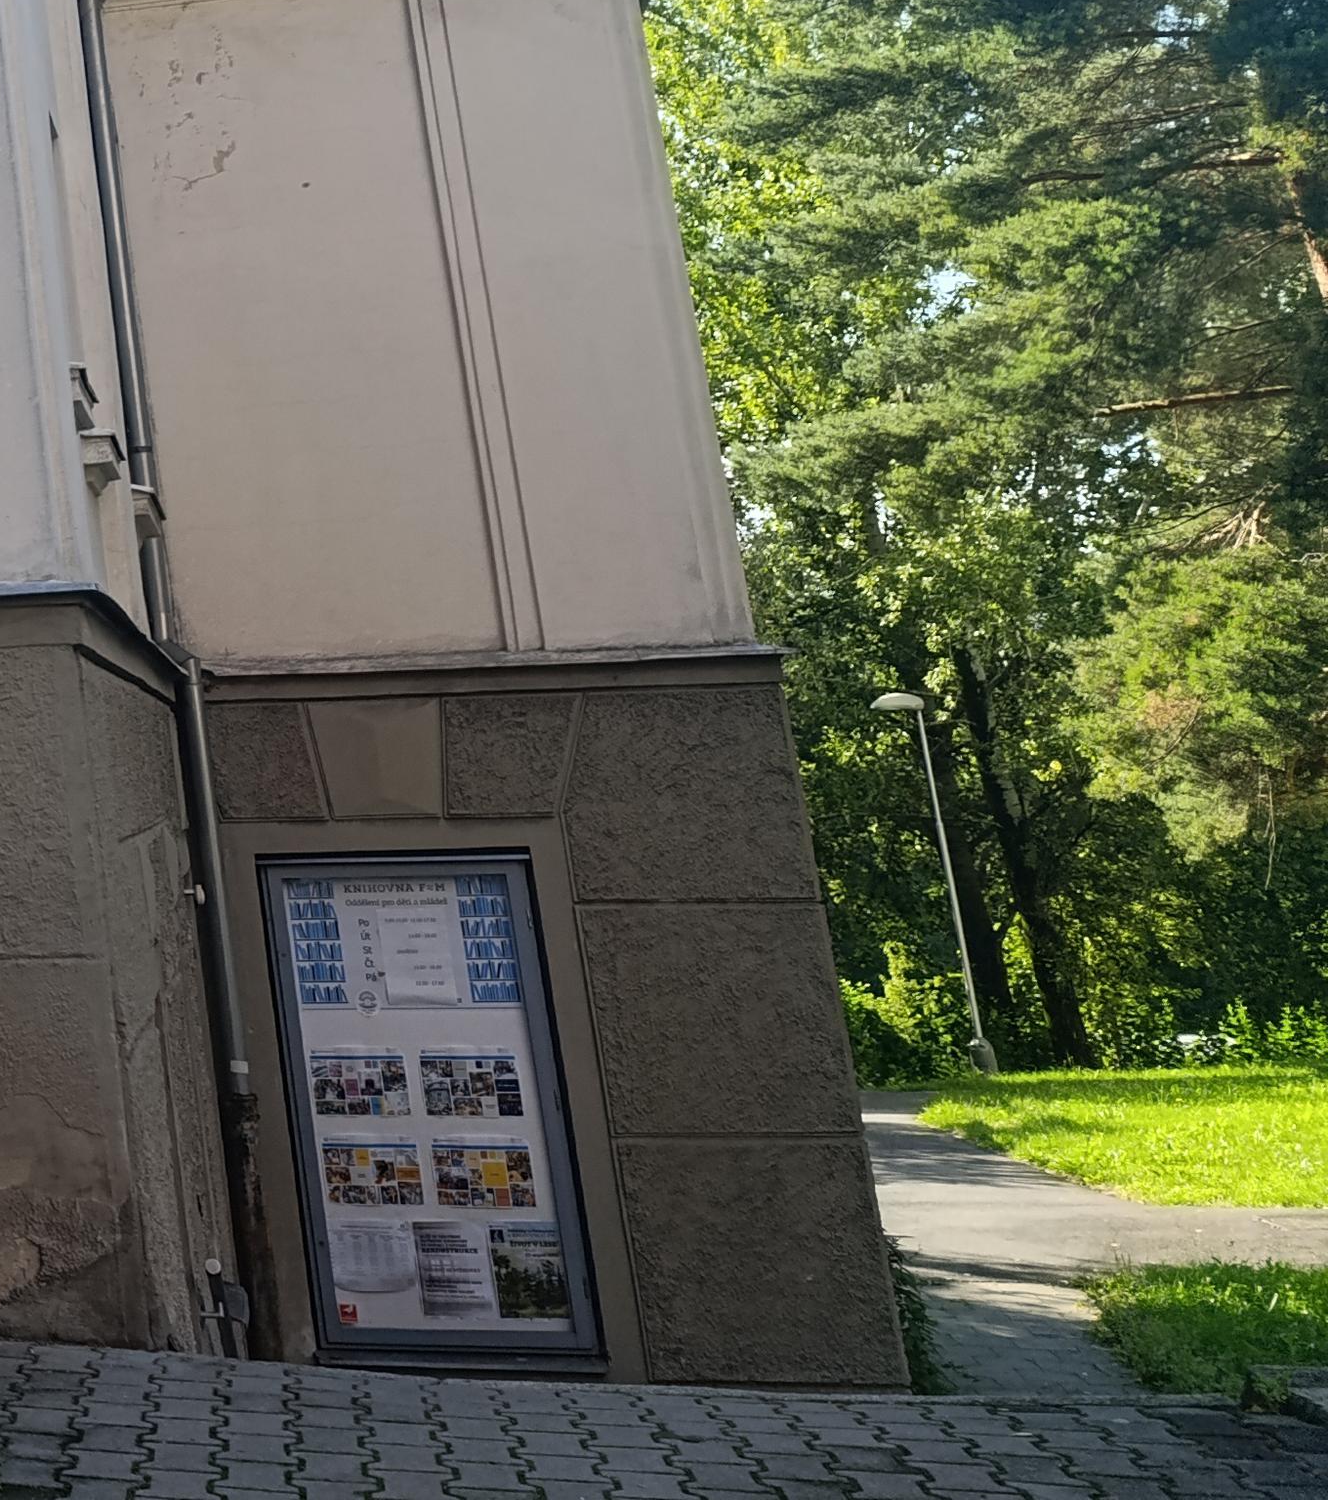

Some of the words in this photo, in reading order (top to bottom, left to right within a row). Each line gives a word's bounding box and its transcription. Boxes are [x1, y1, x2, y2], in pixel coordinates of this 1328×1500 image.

[344, 883, 414, 893] KNIHOVNA
[382, 900, 394, 908] pro
[358, 919, 369, 927] Po
[360, 930, 371, 941] Út
[363, 946, 373, 955] St
[365, 958, 375, 968] Čt
[366, 972, 377, 982] Pá
